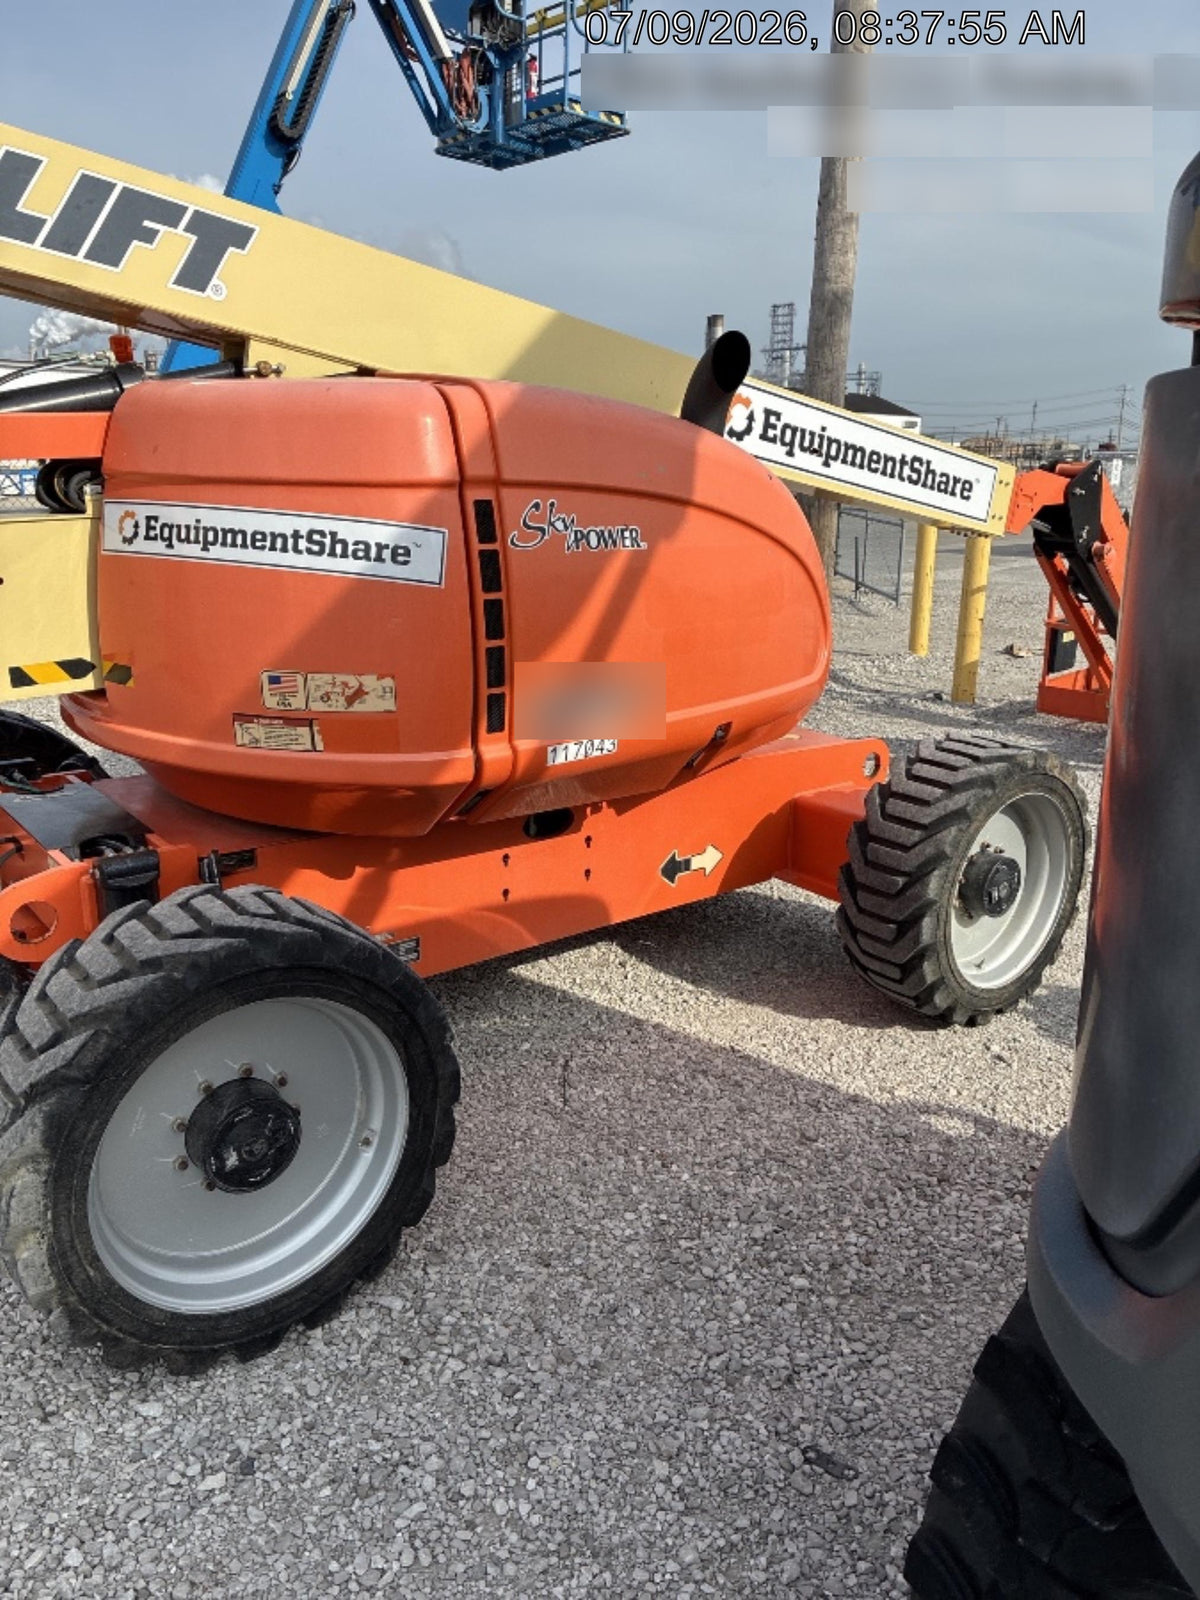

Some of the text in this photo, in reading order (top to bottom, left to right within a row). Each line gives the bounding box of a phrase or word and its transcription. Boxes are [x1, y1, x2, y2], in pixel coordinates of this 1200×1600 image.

[0, 147, 257, 295] LIFT
[759, 407, 974, 500] EquipmentShare
[143, 515, 412, 566] EquipmentShare
[573, 526, 642, 551] POWER
